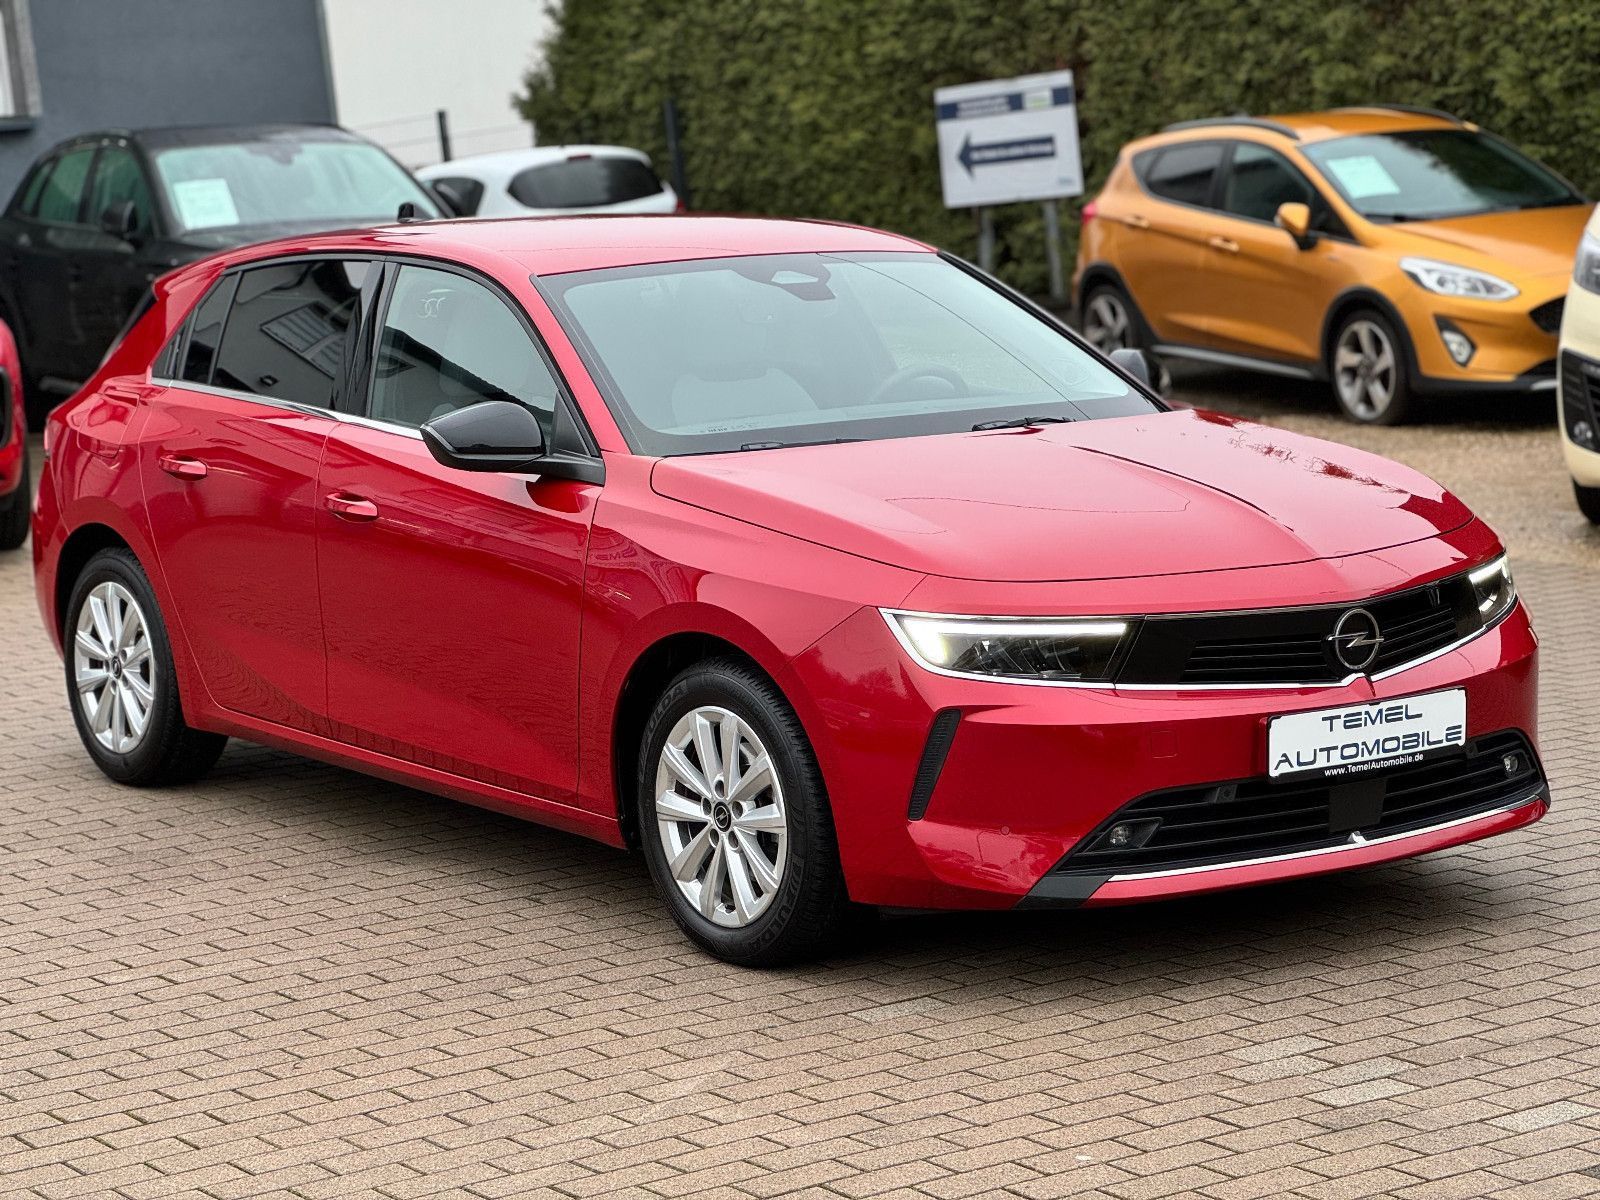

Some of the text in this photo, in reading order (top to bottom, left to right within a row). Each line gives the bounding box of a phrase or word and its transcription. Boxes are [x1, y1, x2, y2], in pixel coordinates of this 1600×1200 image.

[1322, 704, 1422, 732] TEMEL
[1274, 724, 1462, 771] AUTOMOBILE
[1324, 753, 1424, 777] www.TemelAutomobile.de
